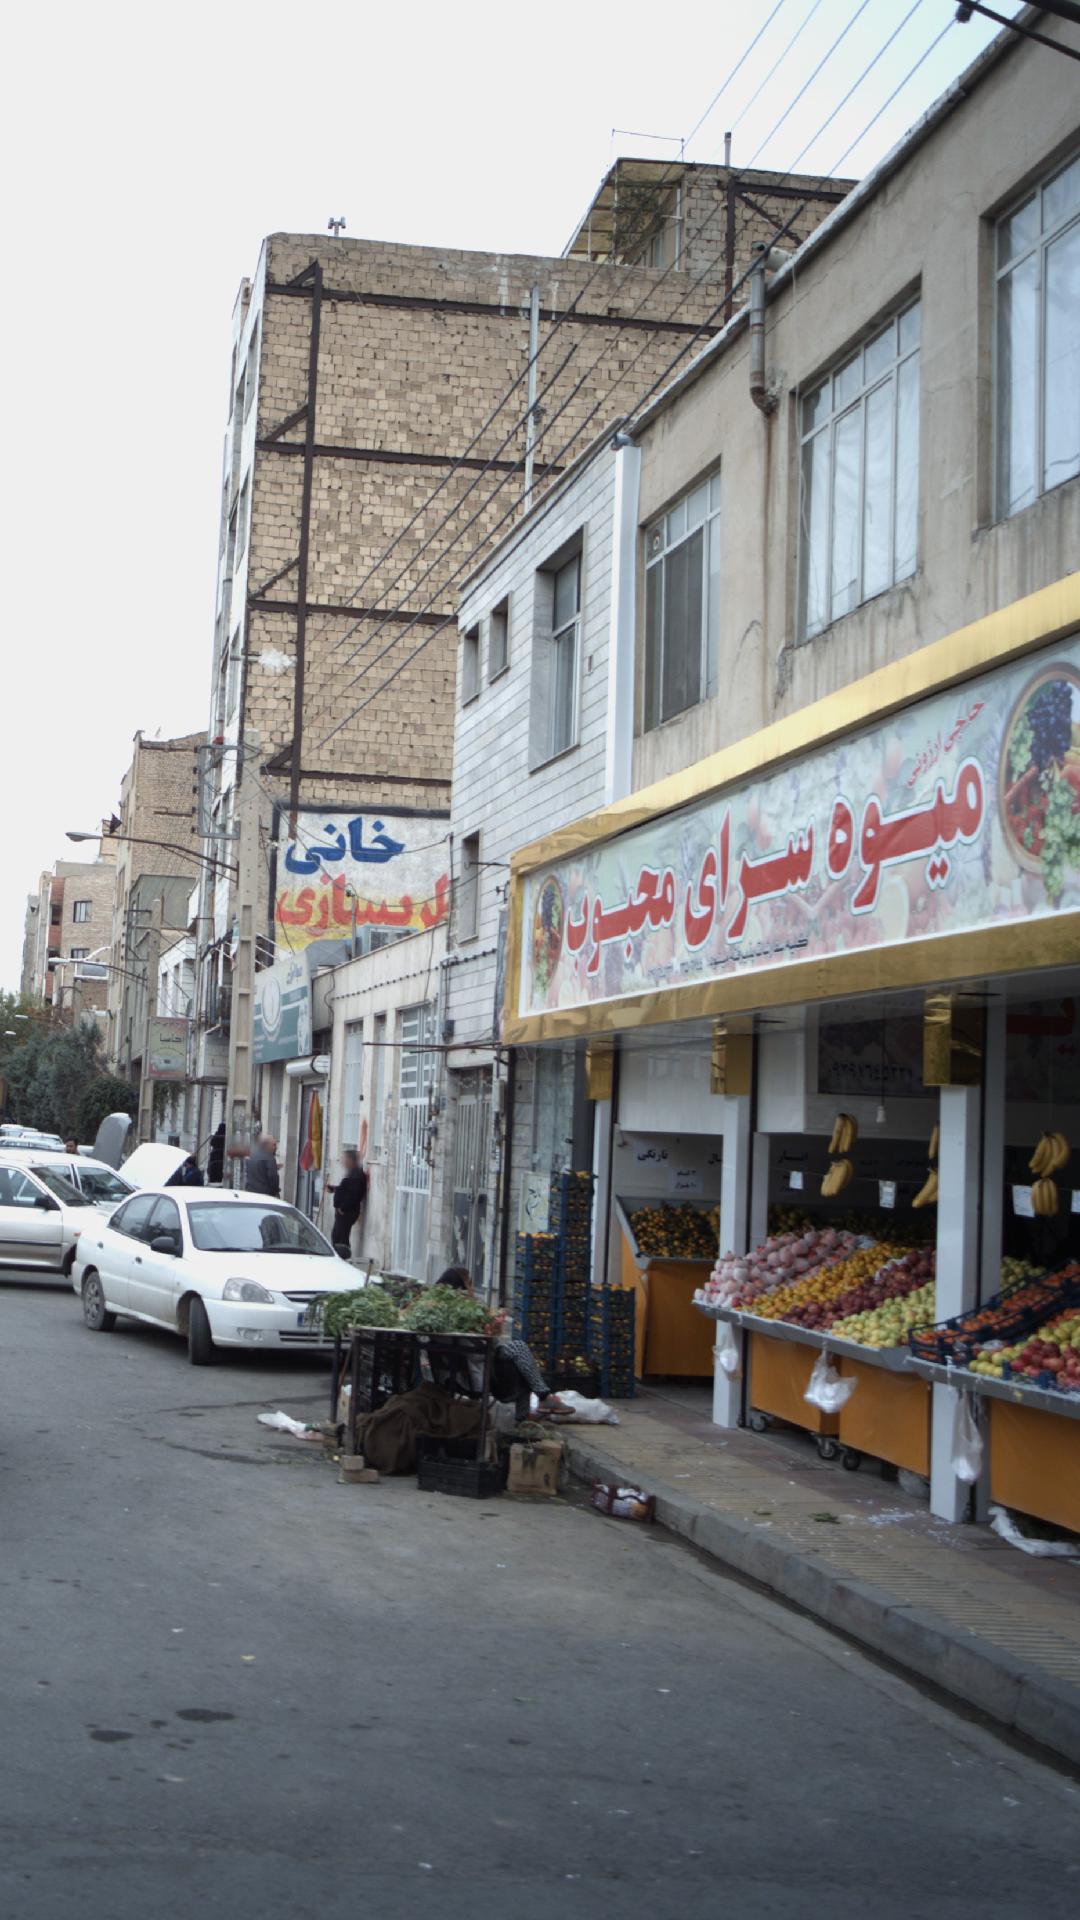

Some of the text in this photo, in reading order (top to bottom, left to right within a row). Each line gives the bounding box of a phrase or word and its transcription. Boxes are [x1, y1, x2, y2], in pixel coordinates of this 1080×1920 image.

[285, 815, 406, 875] خانی
[566, 757, 984, 975] میوه سرای محبوب
